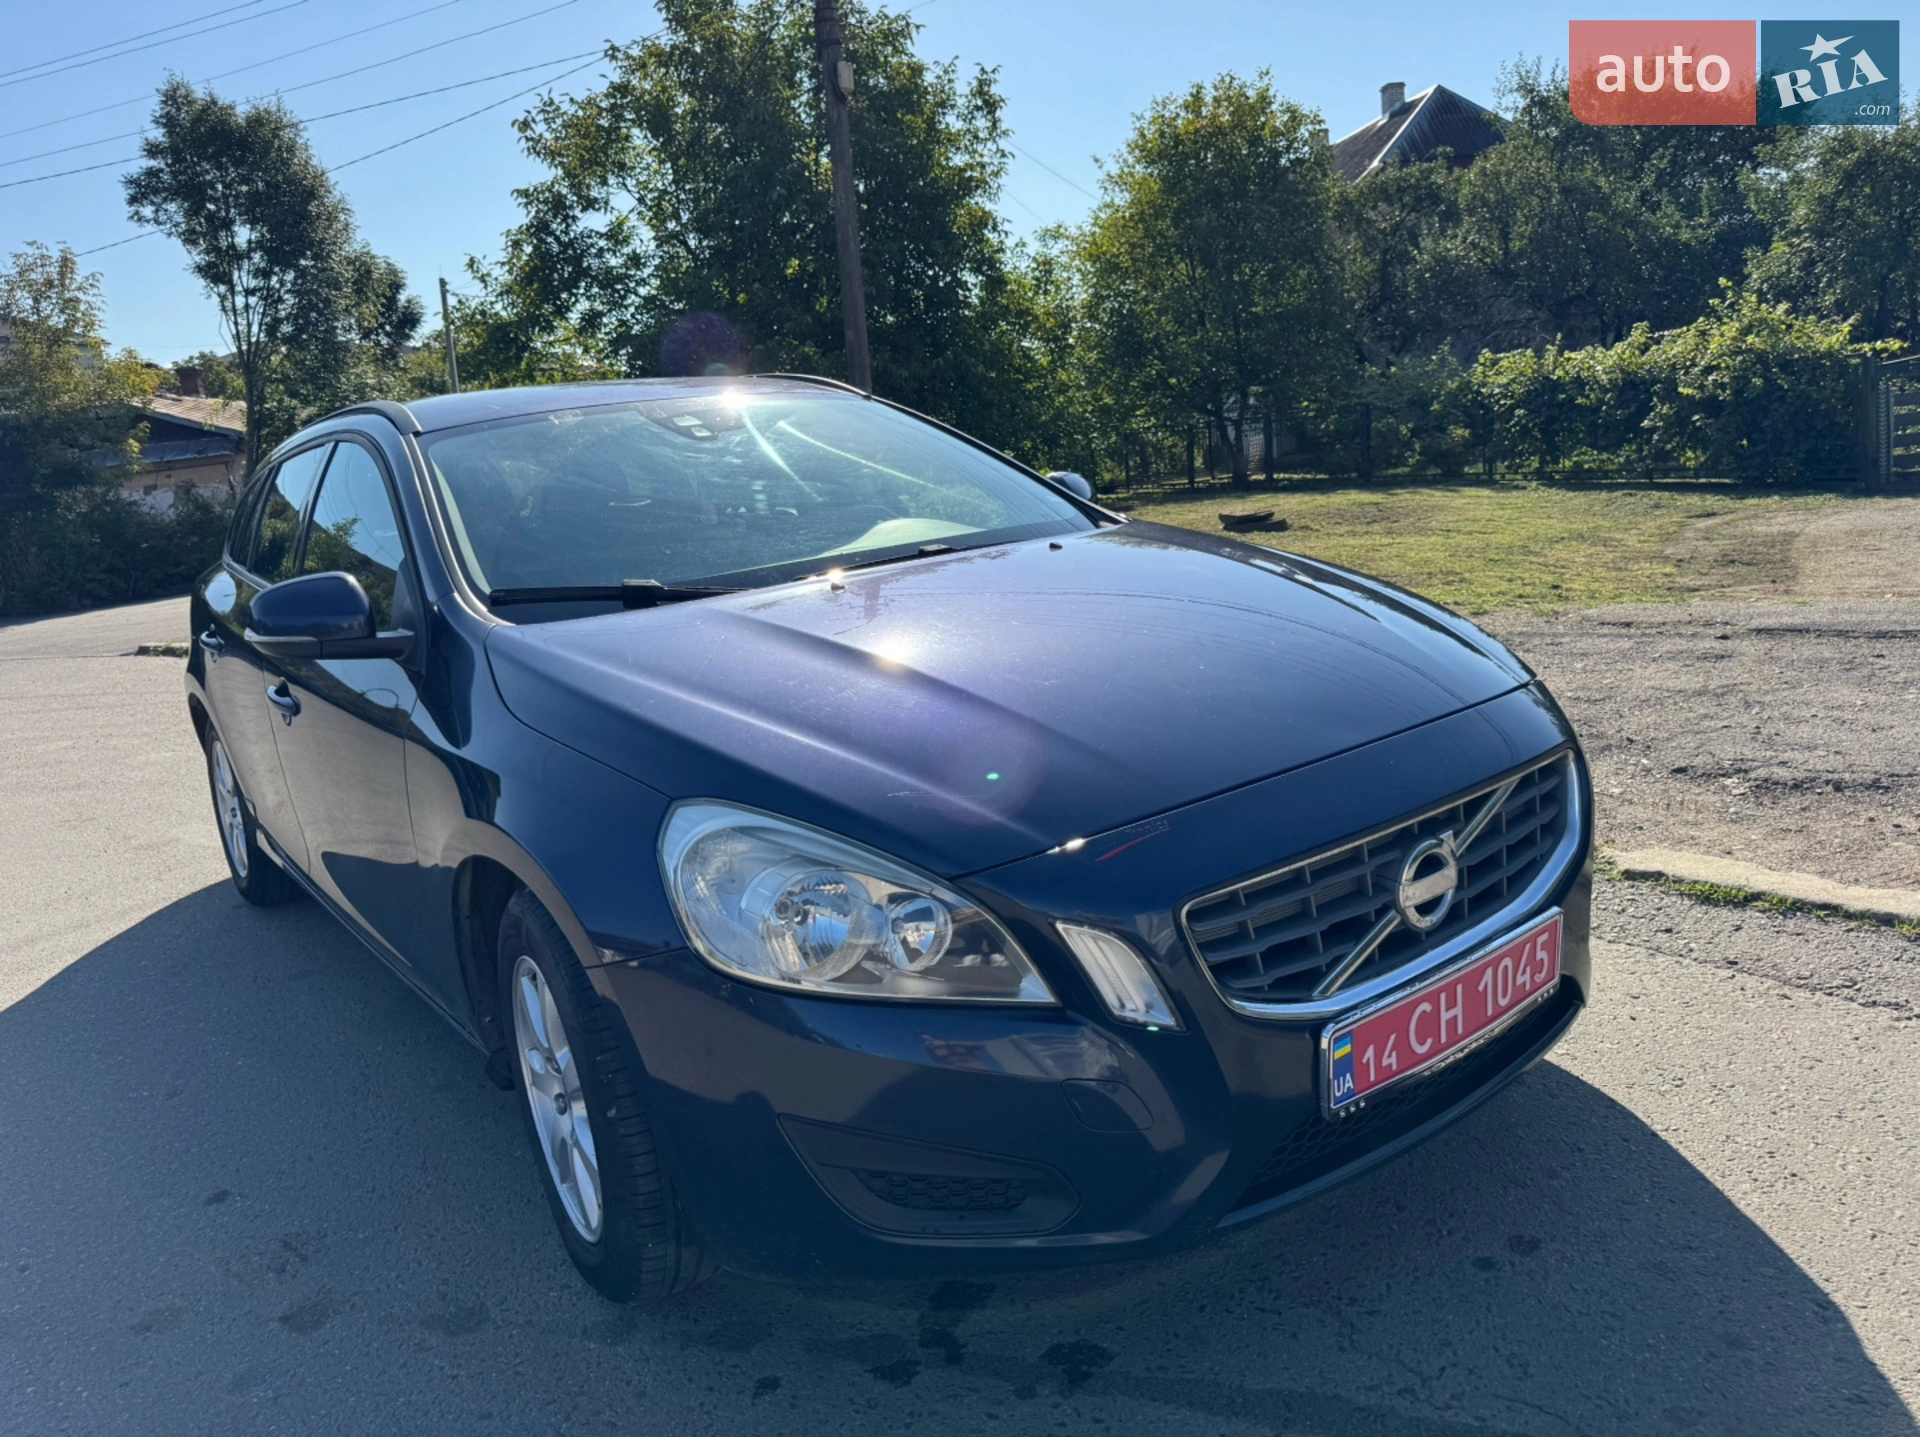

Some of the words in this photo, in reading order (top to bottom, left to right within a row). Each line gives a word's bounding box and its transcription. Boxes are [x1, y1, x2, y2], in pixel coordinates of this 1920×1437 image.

[1361, 1033, 1397, 1082] 14
[1408, 984, 1464, 1055] CH
[1477, 932, 1550, 1017] 1045
[1334, 1074, 1355, 1097] UA
